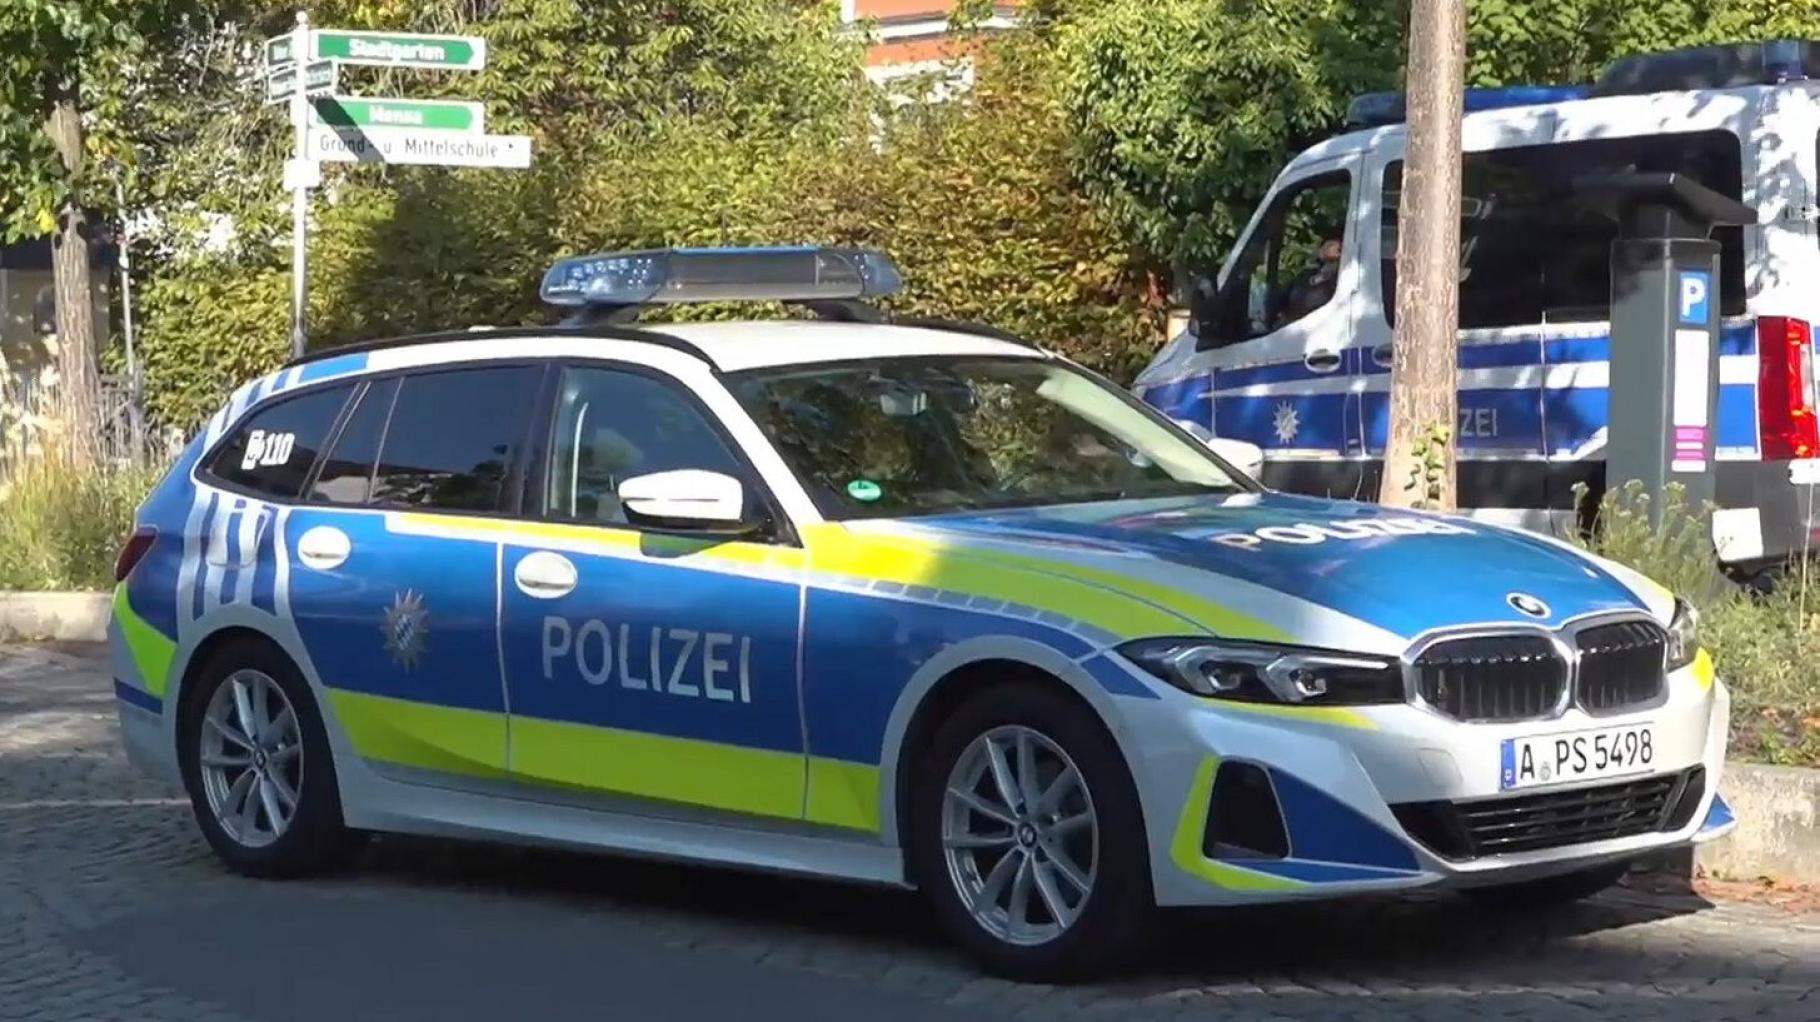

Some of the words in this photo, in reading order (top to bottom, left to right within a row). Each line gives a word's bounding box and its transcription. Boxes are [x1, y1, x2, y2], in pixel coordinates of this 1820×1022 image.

[320, 135, 375, 152] Grund-
[405, 138, 499, 158] Mittelschule
[1681, 278, 1706, 318] P
[542, 615, 752, 703] POLIZEI
[1520, 743, 1535, 780] A
[1556, 737, 1587, 775] PS
[1595, 729, 1652, 770] 5498
